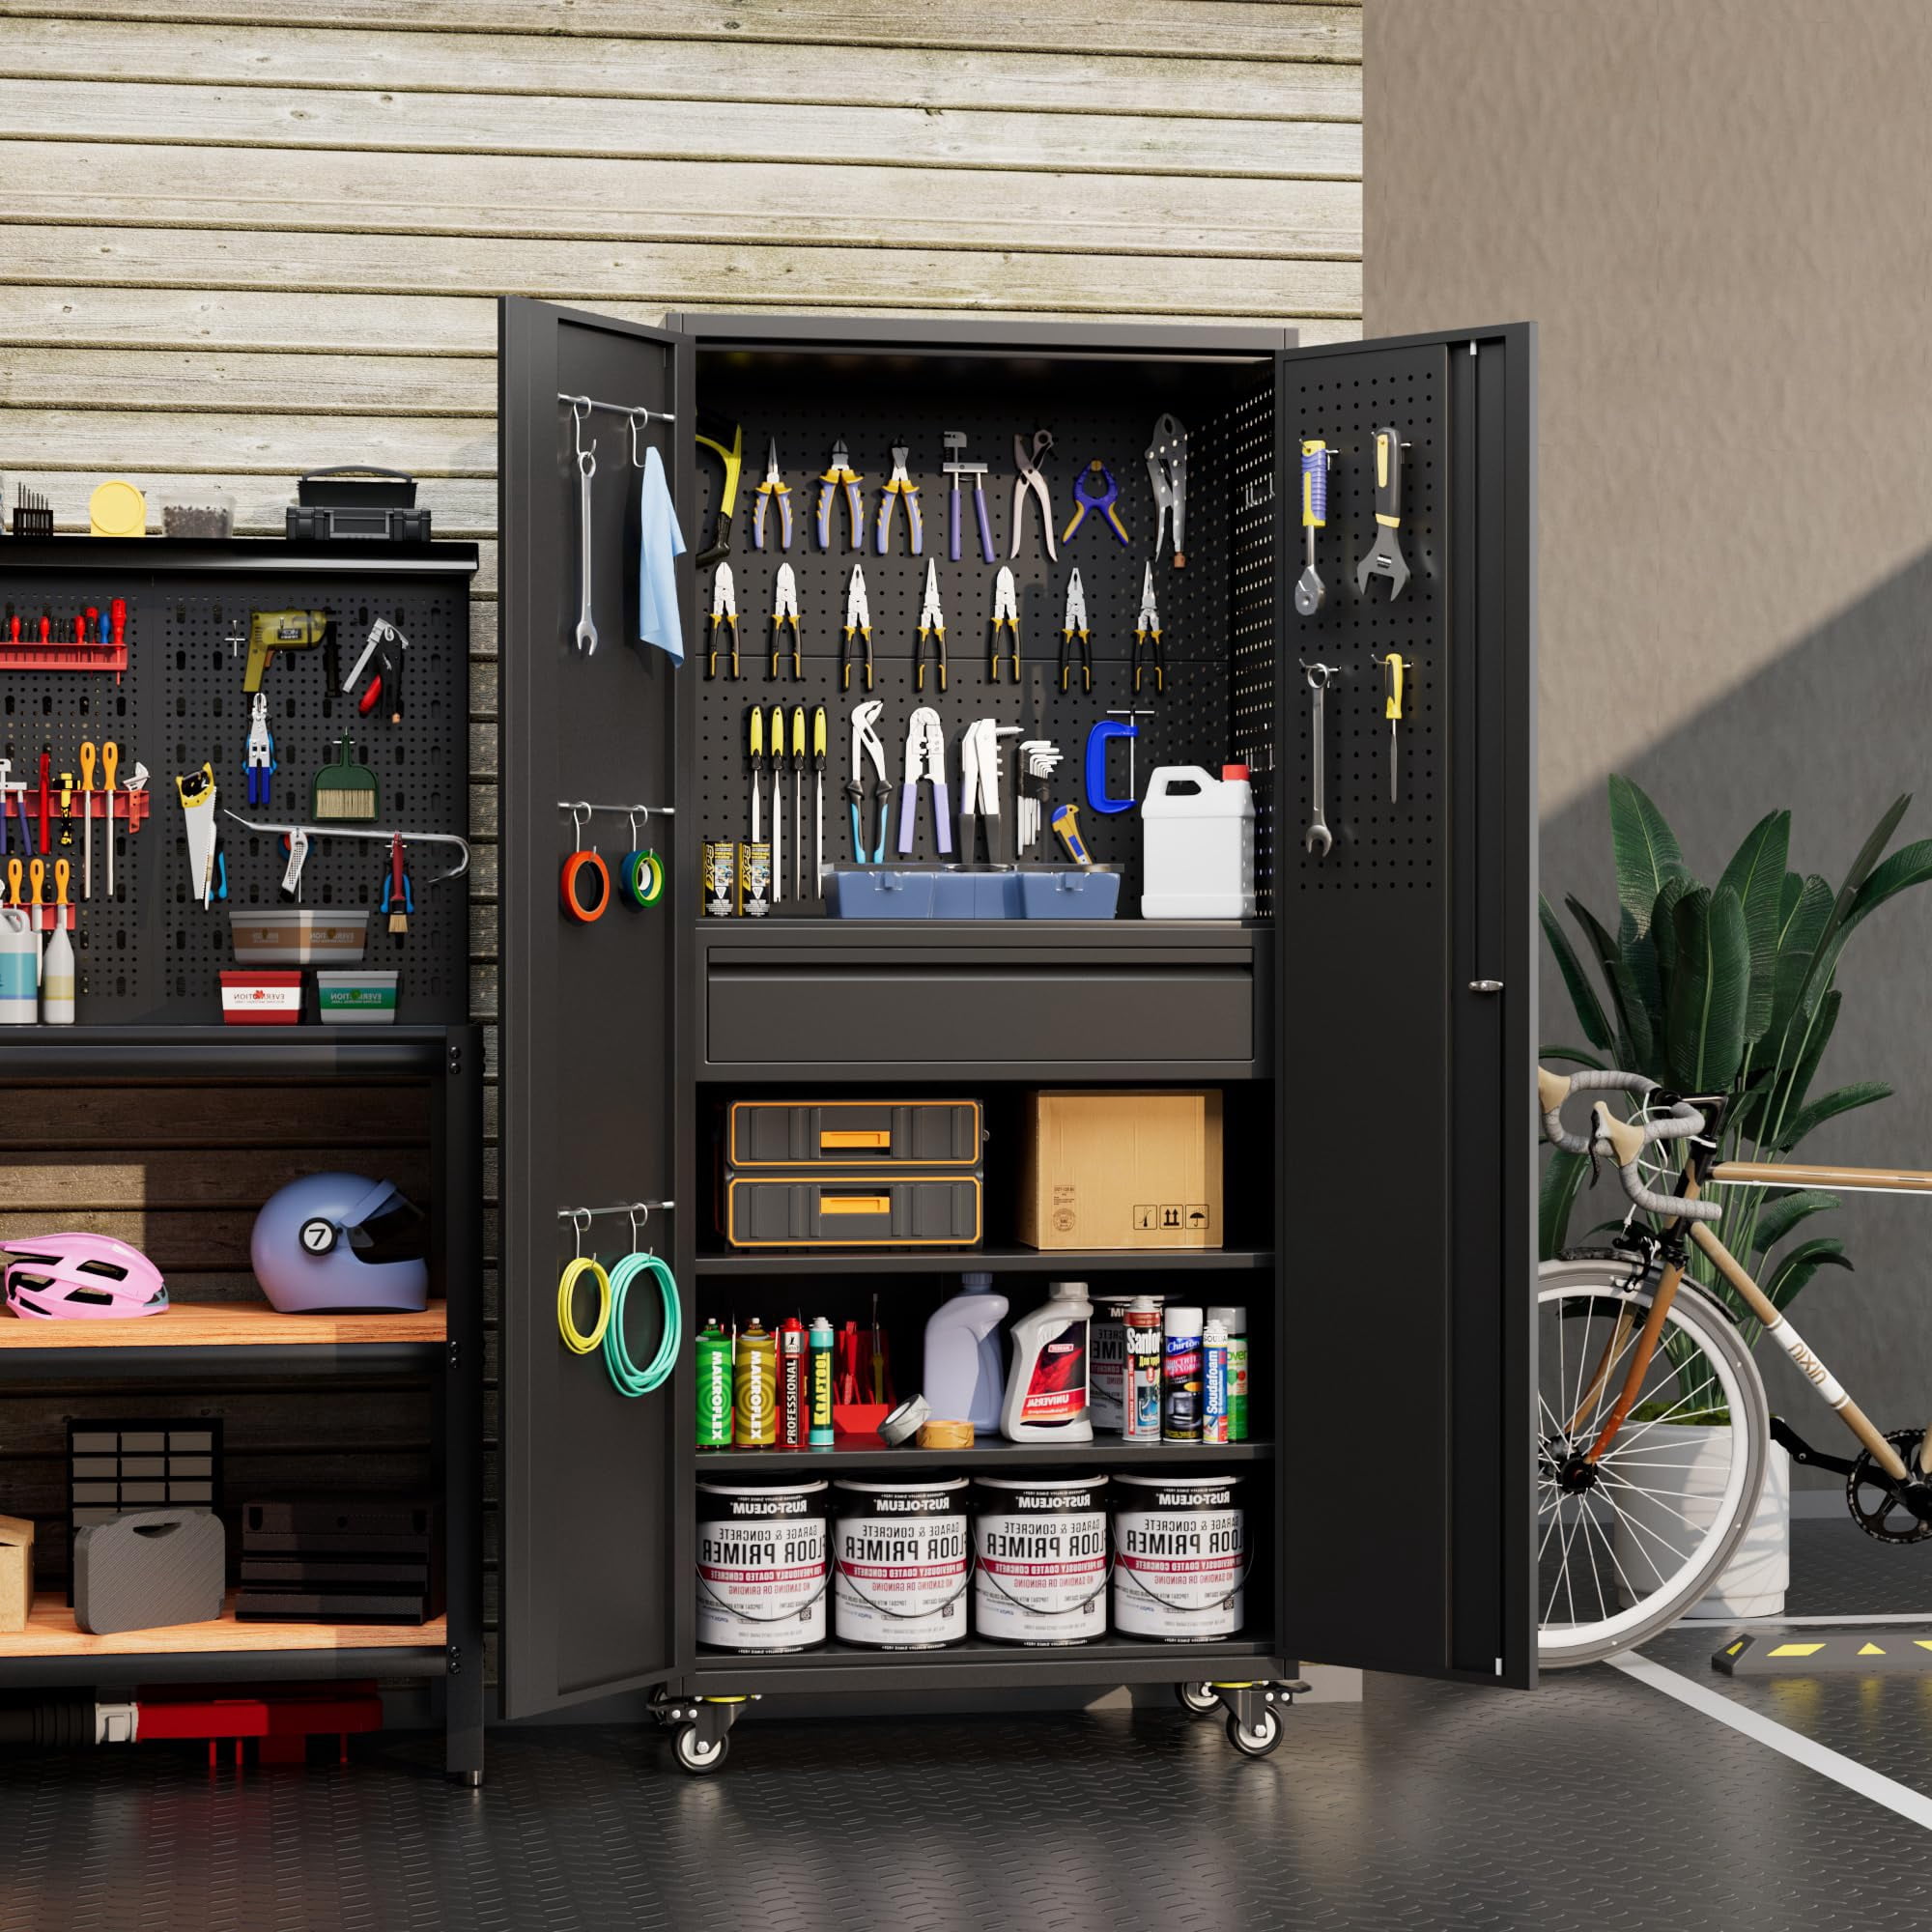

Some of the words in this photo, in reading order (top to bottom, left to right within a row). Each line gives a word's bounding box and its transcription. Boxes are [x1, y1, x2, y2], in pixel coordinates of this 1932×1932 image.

[309, 1229, 326, 1246] 7
[712, 1351, 723, 1440] MAKROFLEX
[751, 1350, 762, 1439] MAKROFLEX
[786, 1359, 796, 1444] PROFESSIONAL
[813, 1351, 827, 1425] KRAFTOOL
[1207, 1350, 1218, 1415] Soudafoam
